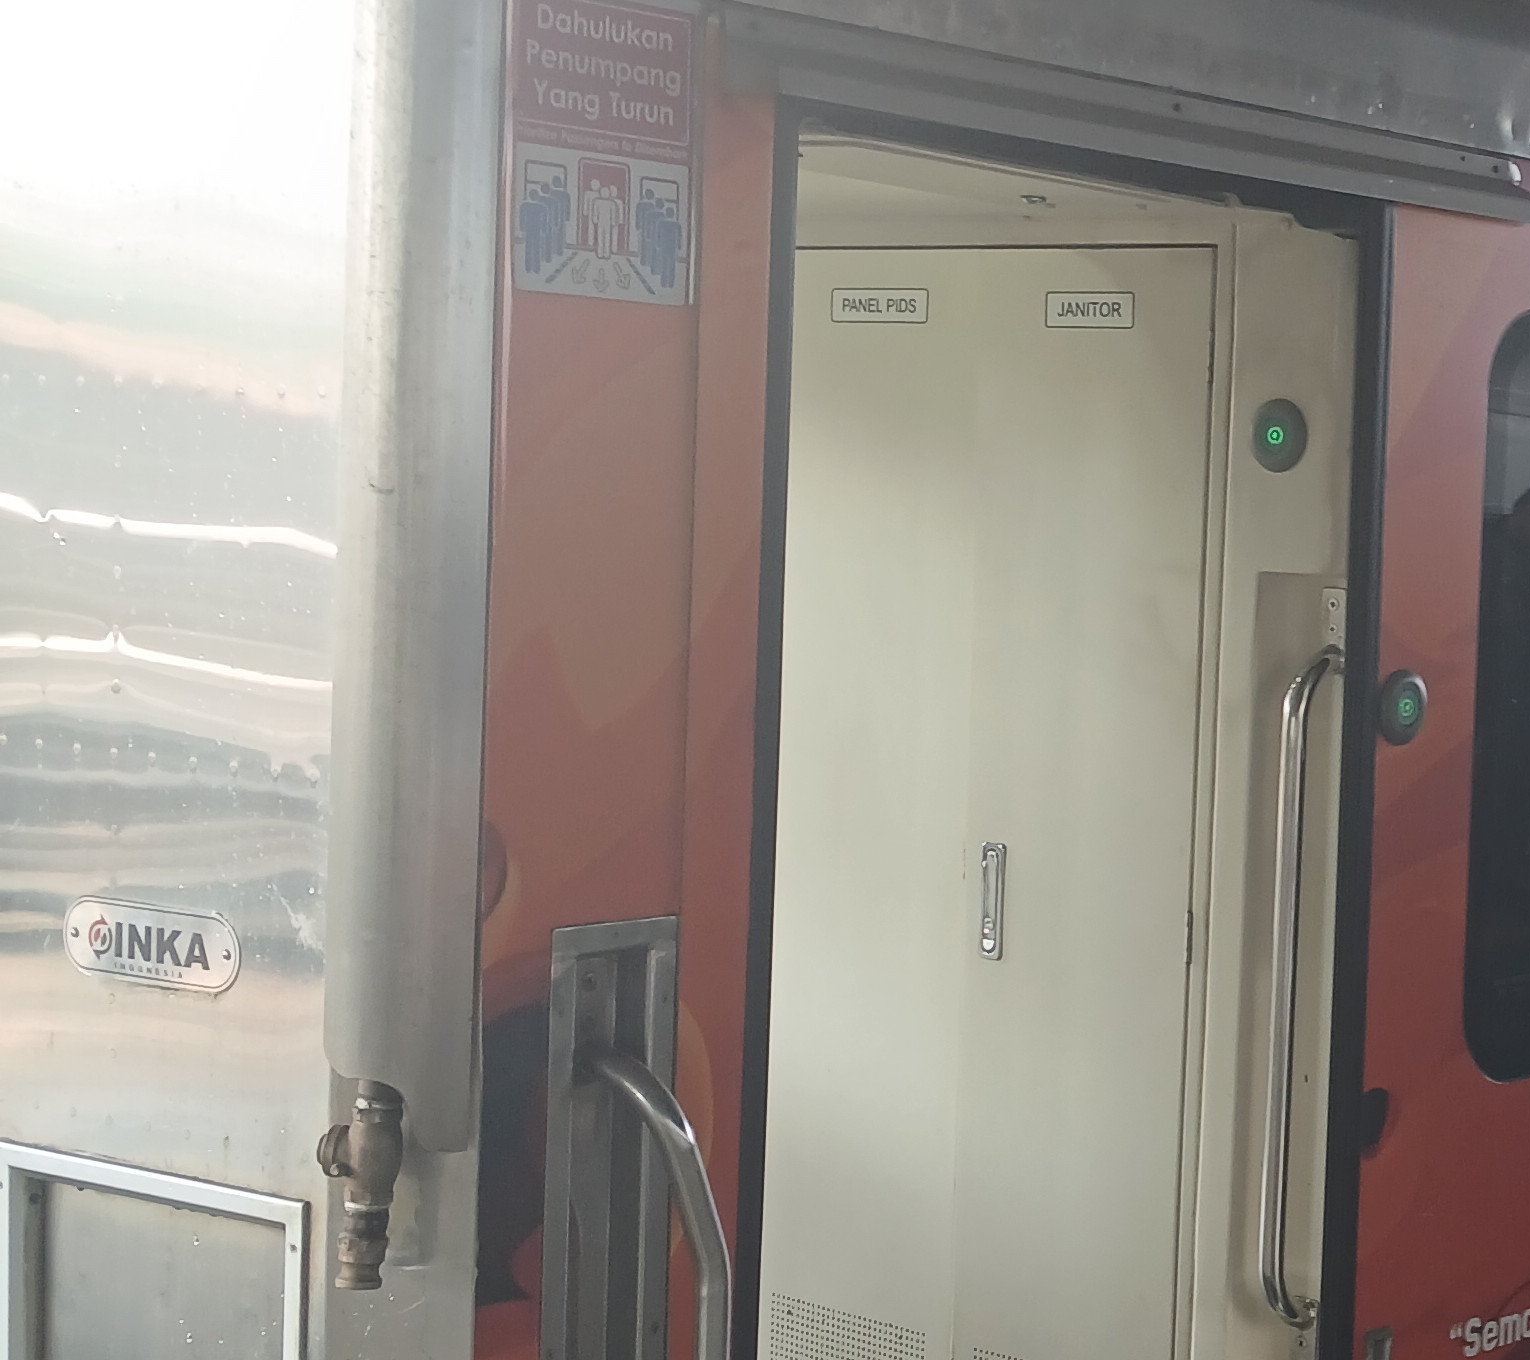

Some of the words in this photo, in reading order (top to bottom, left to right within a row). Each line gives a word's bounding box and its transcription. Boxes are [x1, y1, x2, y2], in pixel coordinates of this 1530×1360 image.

[537, 2, 674, 52] Dahulukan
[526, 38, 682, 97] Penumpang
[533, 77, 600, 120] Yang
[608, 90, 674, 126] Turun
[841, 297, 882, 314] PANEL
[885, 297, 918, 314] PIDS
[1056, 301, 1123, 318] JANITOR
[114, 921, 211, 971] INKA
